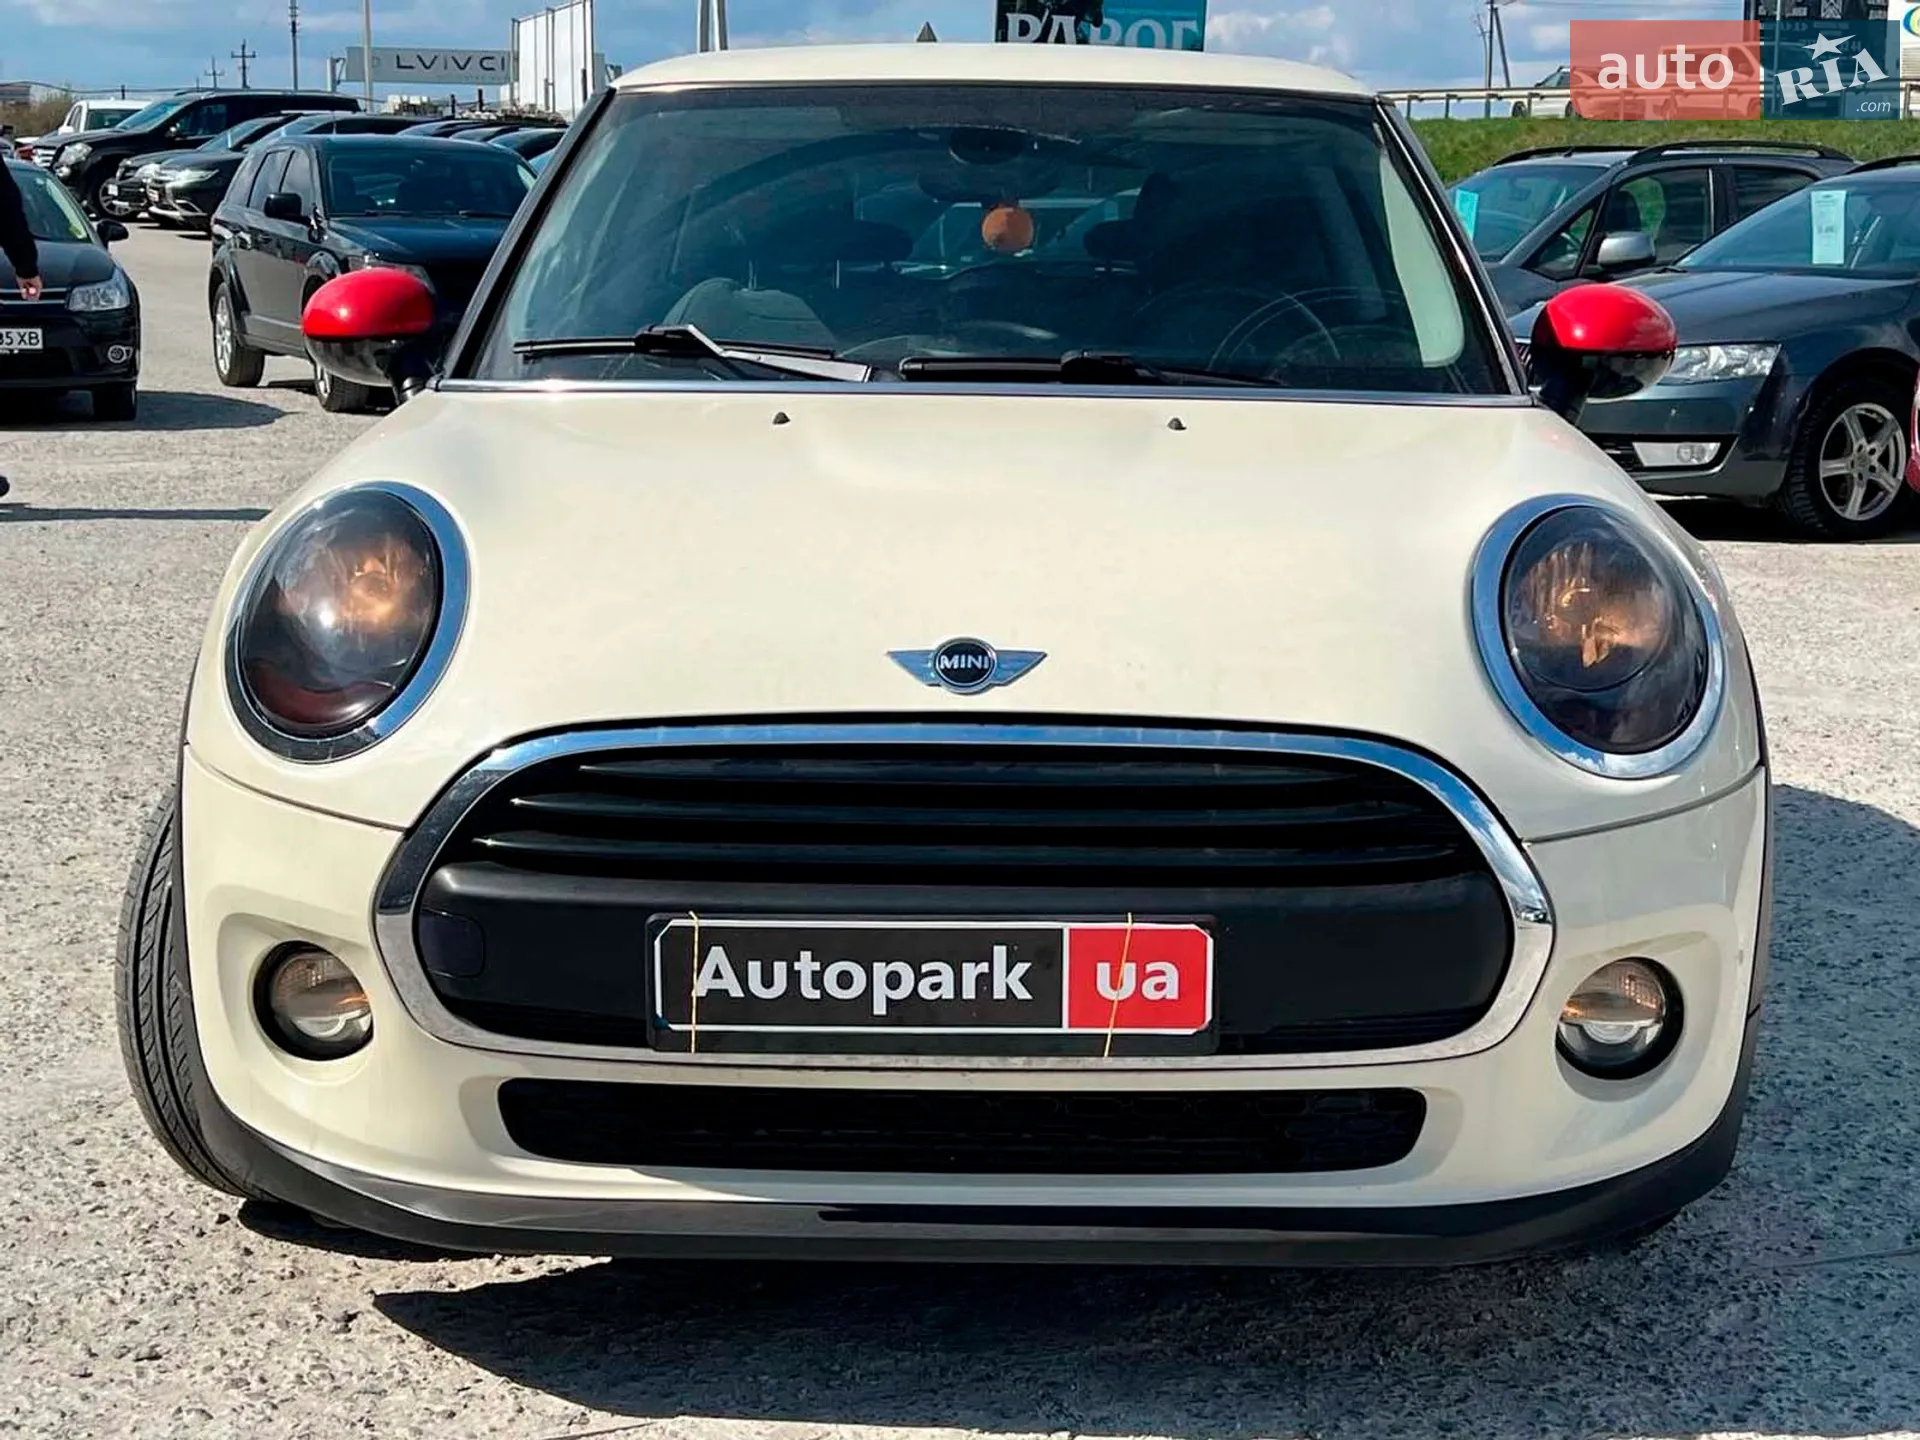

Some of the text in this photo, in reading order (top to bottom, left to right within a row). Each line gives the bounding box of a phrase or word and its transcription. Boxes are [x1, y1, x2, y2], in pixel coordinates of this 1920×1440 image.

[17, 331, 40, 346] XB
[940, 654, 989, 670] MINI
[696, 945, 1180, 1016] Autopark ua
